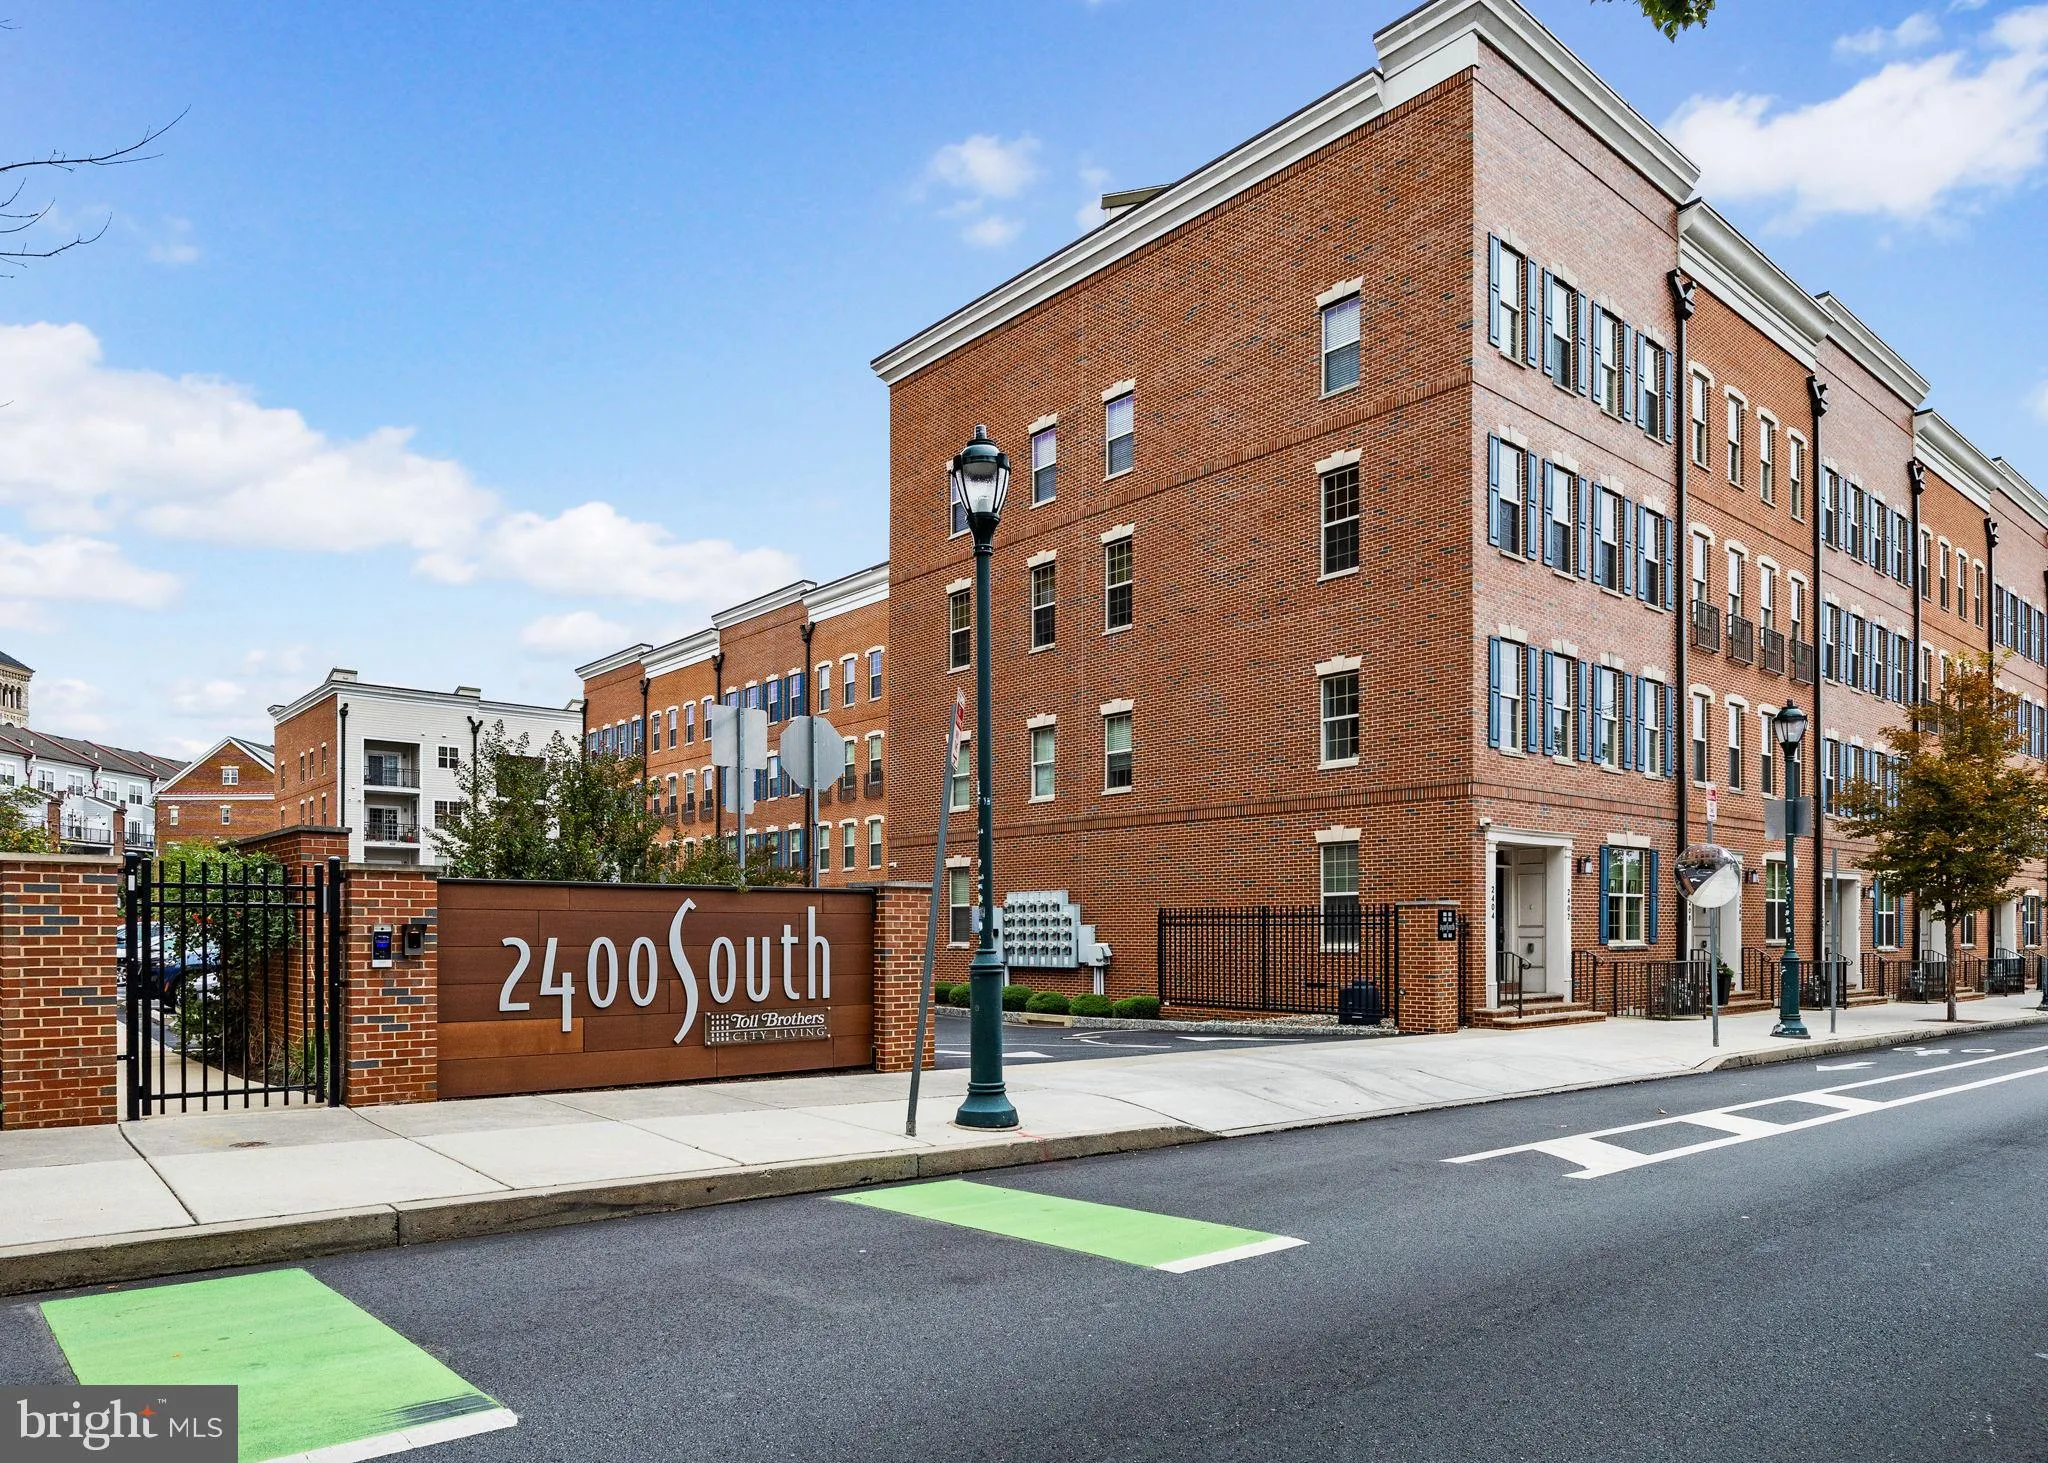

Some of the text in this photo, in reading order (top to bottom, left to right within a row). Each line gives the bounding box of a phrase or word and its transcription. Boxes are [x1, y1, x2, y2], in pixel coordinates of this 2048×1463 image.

[730, 1011, 825, 1029] Toll Brothers
[732, 1027, 825, 1041] CITY LIVING
